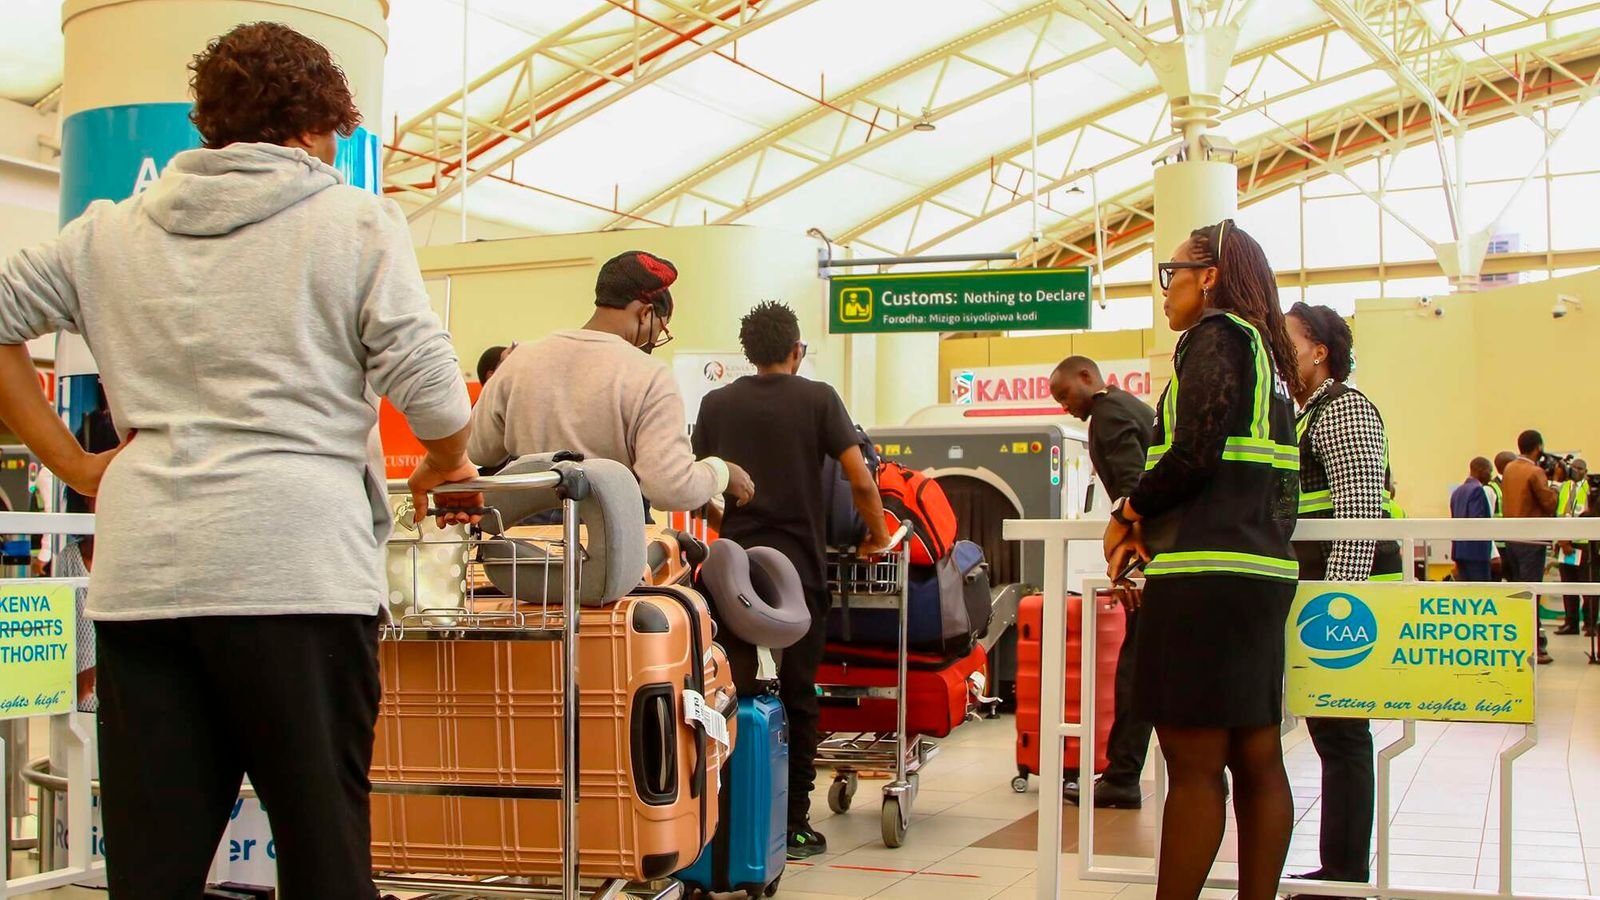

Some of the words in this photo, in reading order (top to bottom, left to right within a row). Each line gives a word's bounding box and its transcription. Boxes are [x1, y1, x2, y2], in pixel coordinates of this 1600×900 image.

[881, 290, 958, 306] Customs:
[964, 291, 1016, 306] Nothing
[1019, 291, 1033, 303] to
[1036, 289, 1086, 302] Declare
[882, 314, 928, 325] Forodha:
[929, 314, 961, 325] Mizigo
[962, 312, 1014, 325] isiyolipiwa
[1016, 311, 1038, 321] kodi
[1420, 598, 1498, 616] KENYA
[1326, 625, 1369, 642] KAA
[1398, 623, 1518, 641] AIRPORTS
[1391, 648, 1526, 667] AUTHORITY
[1384, 701, 1413, 711] our
[1417, 698, 1468, 715] sights
